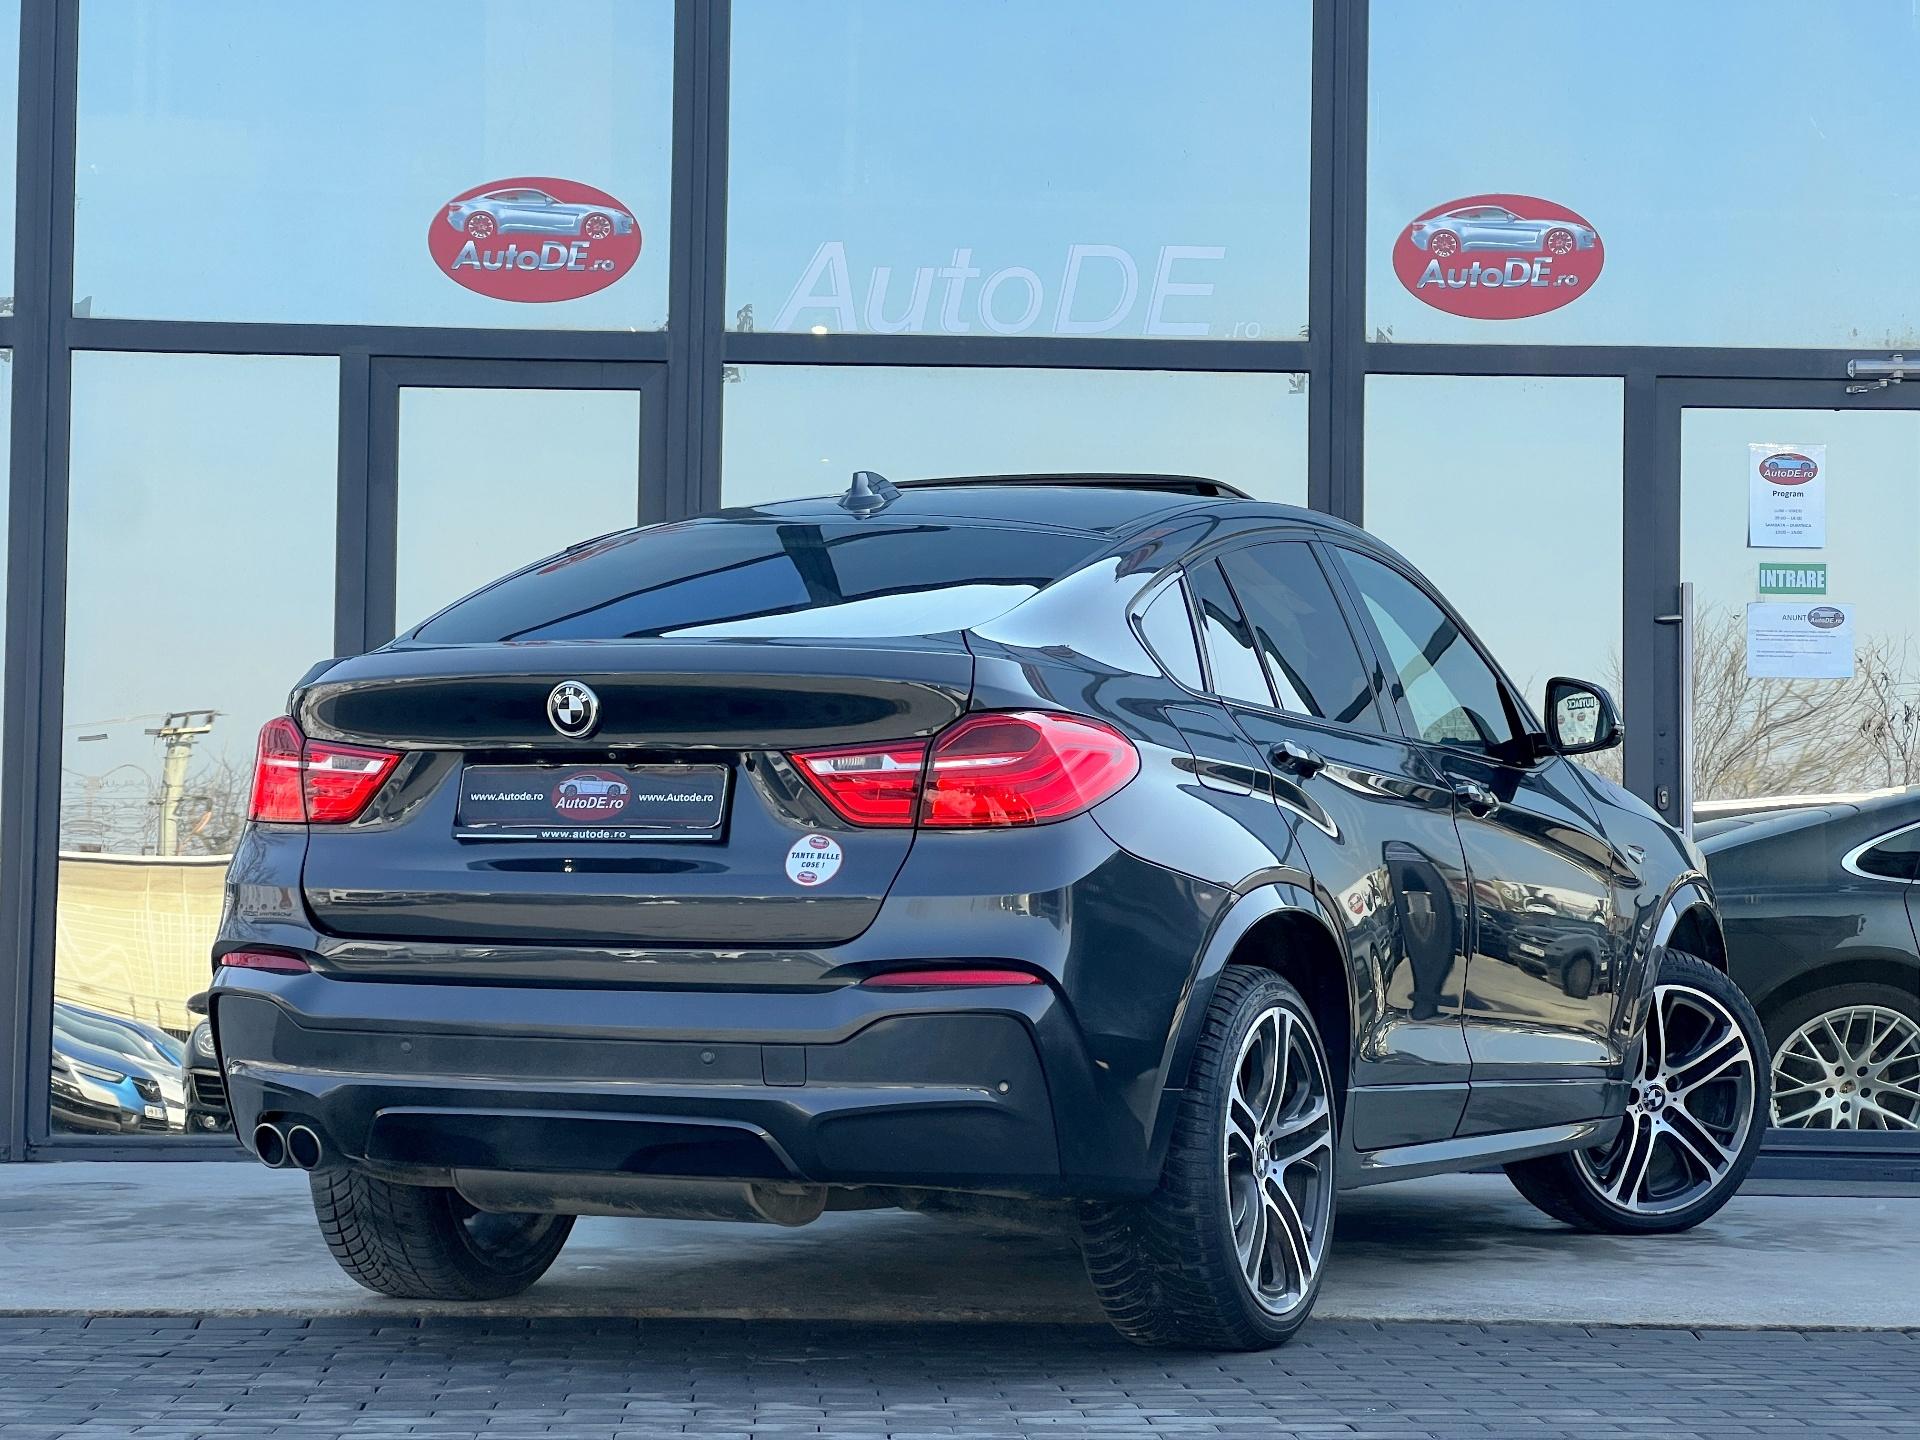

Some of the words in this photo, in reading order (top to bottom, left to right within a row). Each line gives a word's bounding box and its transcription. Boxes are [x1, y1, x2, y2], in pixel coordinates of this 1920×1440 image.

[1763, 469, 1814, 478] AutoDE.ro
[1772, 490, 1804, 498] Program
[1760, 569, 1825, 588] INTRARE
[554, 688, 589, 703] BMW
[470, 791, 544, 801] www.Autode.ro
[638, 792, 714, 802] www.Autode.ro
[555, 796, 624, 809] AutoDE.ro
[541, 829, 627, 839] www.autode.ro
